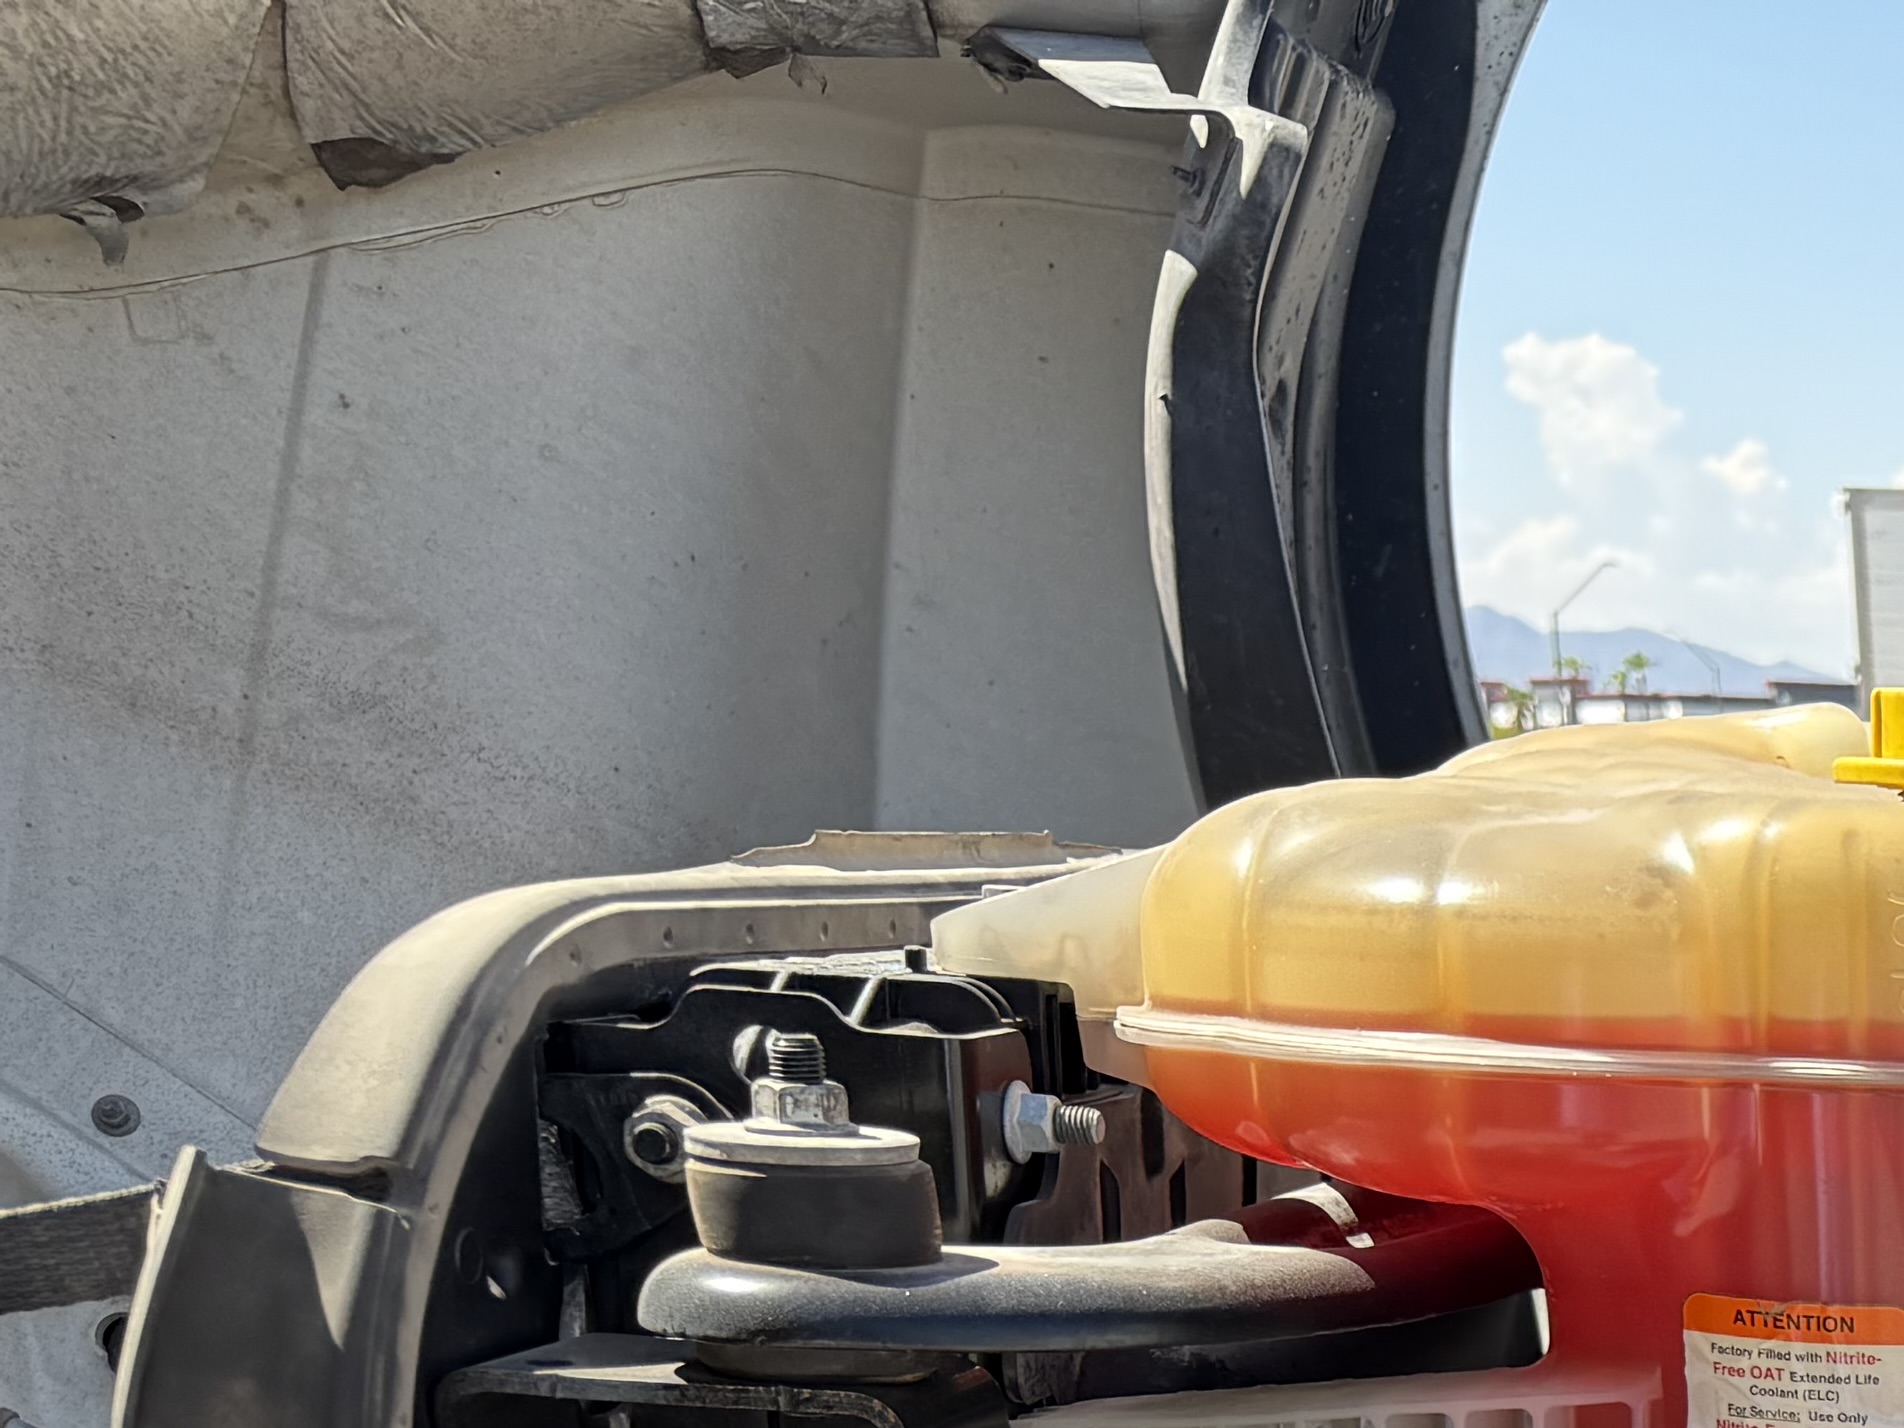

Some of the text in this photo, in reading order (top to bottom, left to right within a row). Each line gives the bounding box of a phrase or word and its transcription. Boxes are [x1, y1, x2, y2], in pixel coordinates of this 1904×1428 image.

[1734, 1309, 1855, 1333] ATTENTION
[1711, 1343, 1753, 1360] Factory
[1758, 1349, 1791, 1362] Filled
[1795, 1352, 1822, 1363] with
[1714, 1363, 1879, 1385] Free OAT Extended Life
[1750, 1386, 1839, 1403] Coolant (ELC)
[1728, 1404, 1747, 1416] For
[1809, 1412, 1833, 1423] Use
[1838, 1413, 1868, 1426] Only
